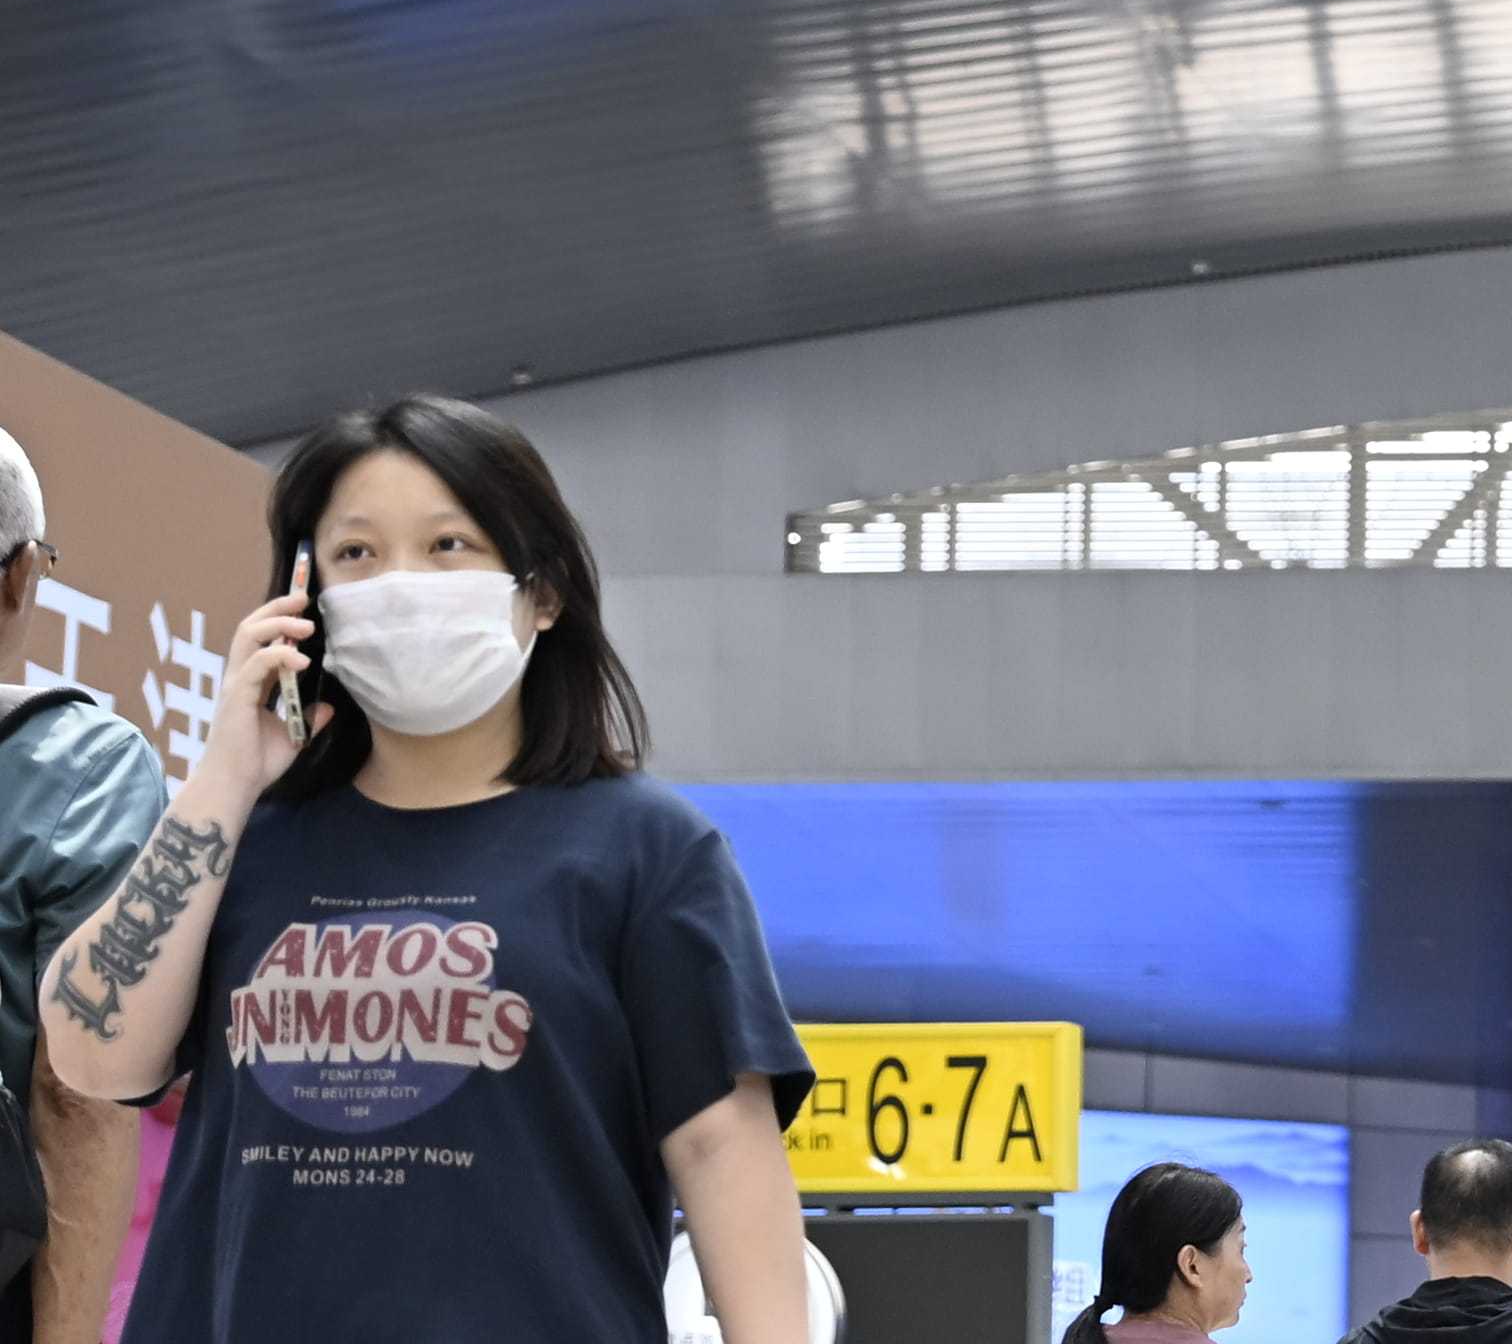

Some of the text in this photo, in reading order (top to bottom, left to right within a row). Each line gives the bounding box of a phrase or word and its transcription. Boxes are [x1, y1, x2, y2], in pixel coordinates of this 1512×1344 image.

[256, 925, 493, 979] AMOS
[295, 989, 533, 1057] MONES
[293, 1086, 318, 1099] THE
[308, 1147, 350, 1163] AND
[354, 1147, 420, 1163] HAPPY
[424, 1147, 474, 1168] NOW
[293, 1168, 406, 1185] MONS 24-28
